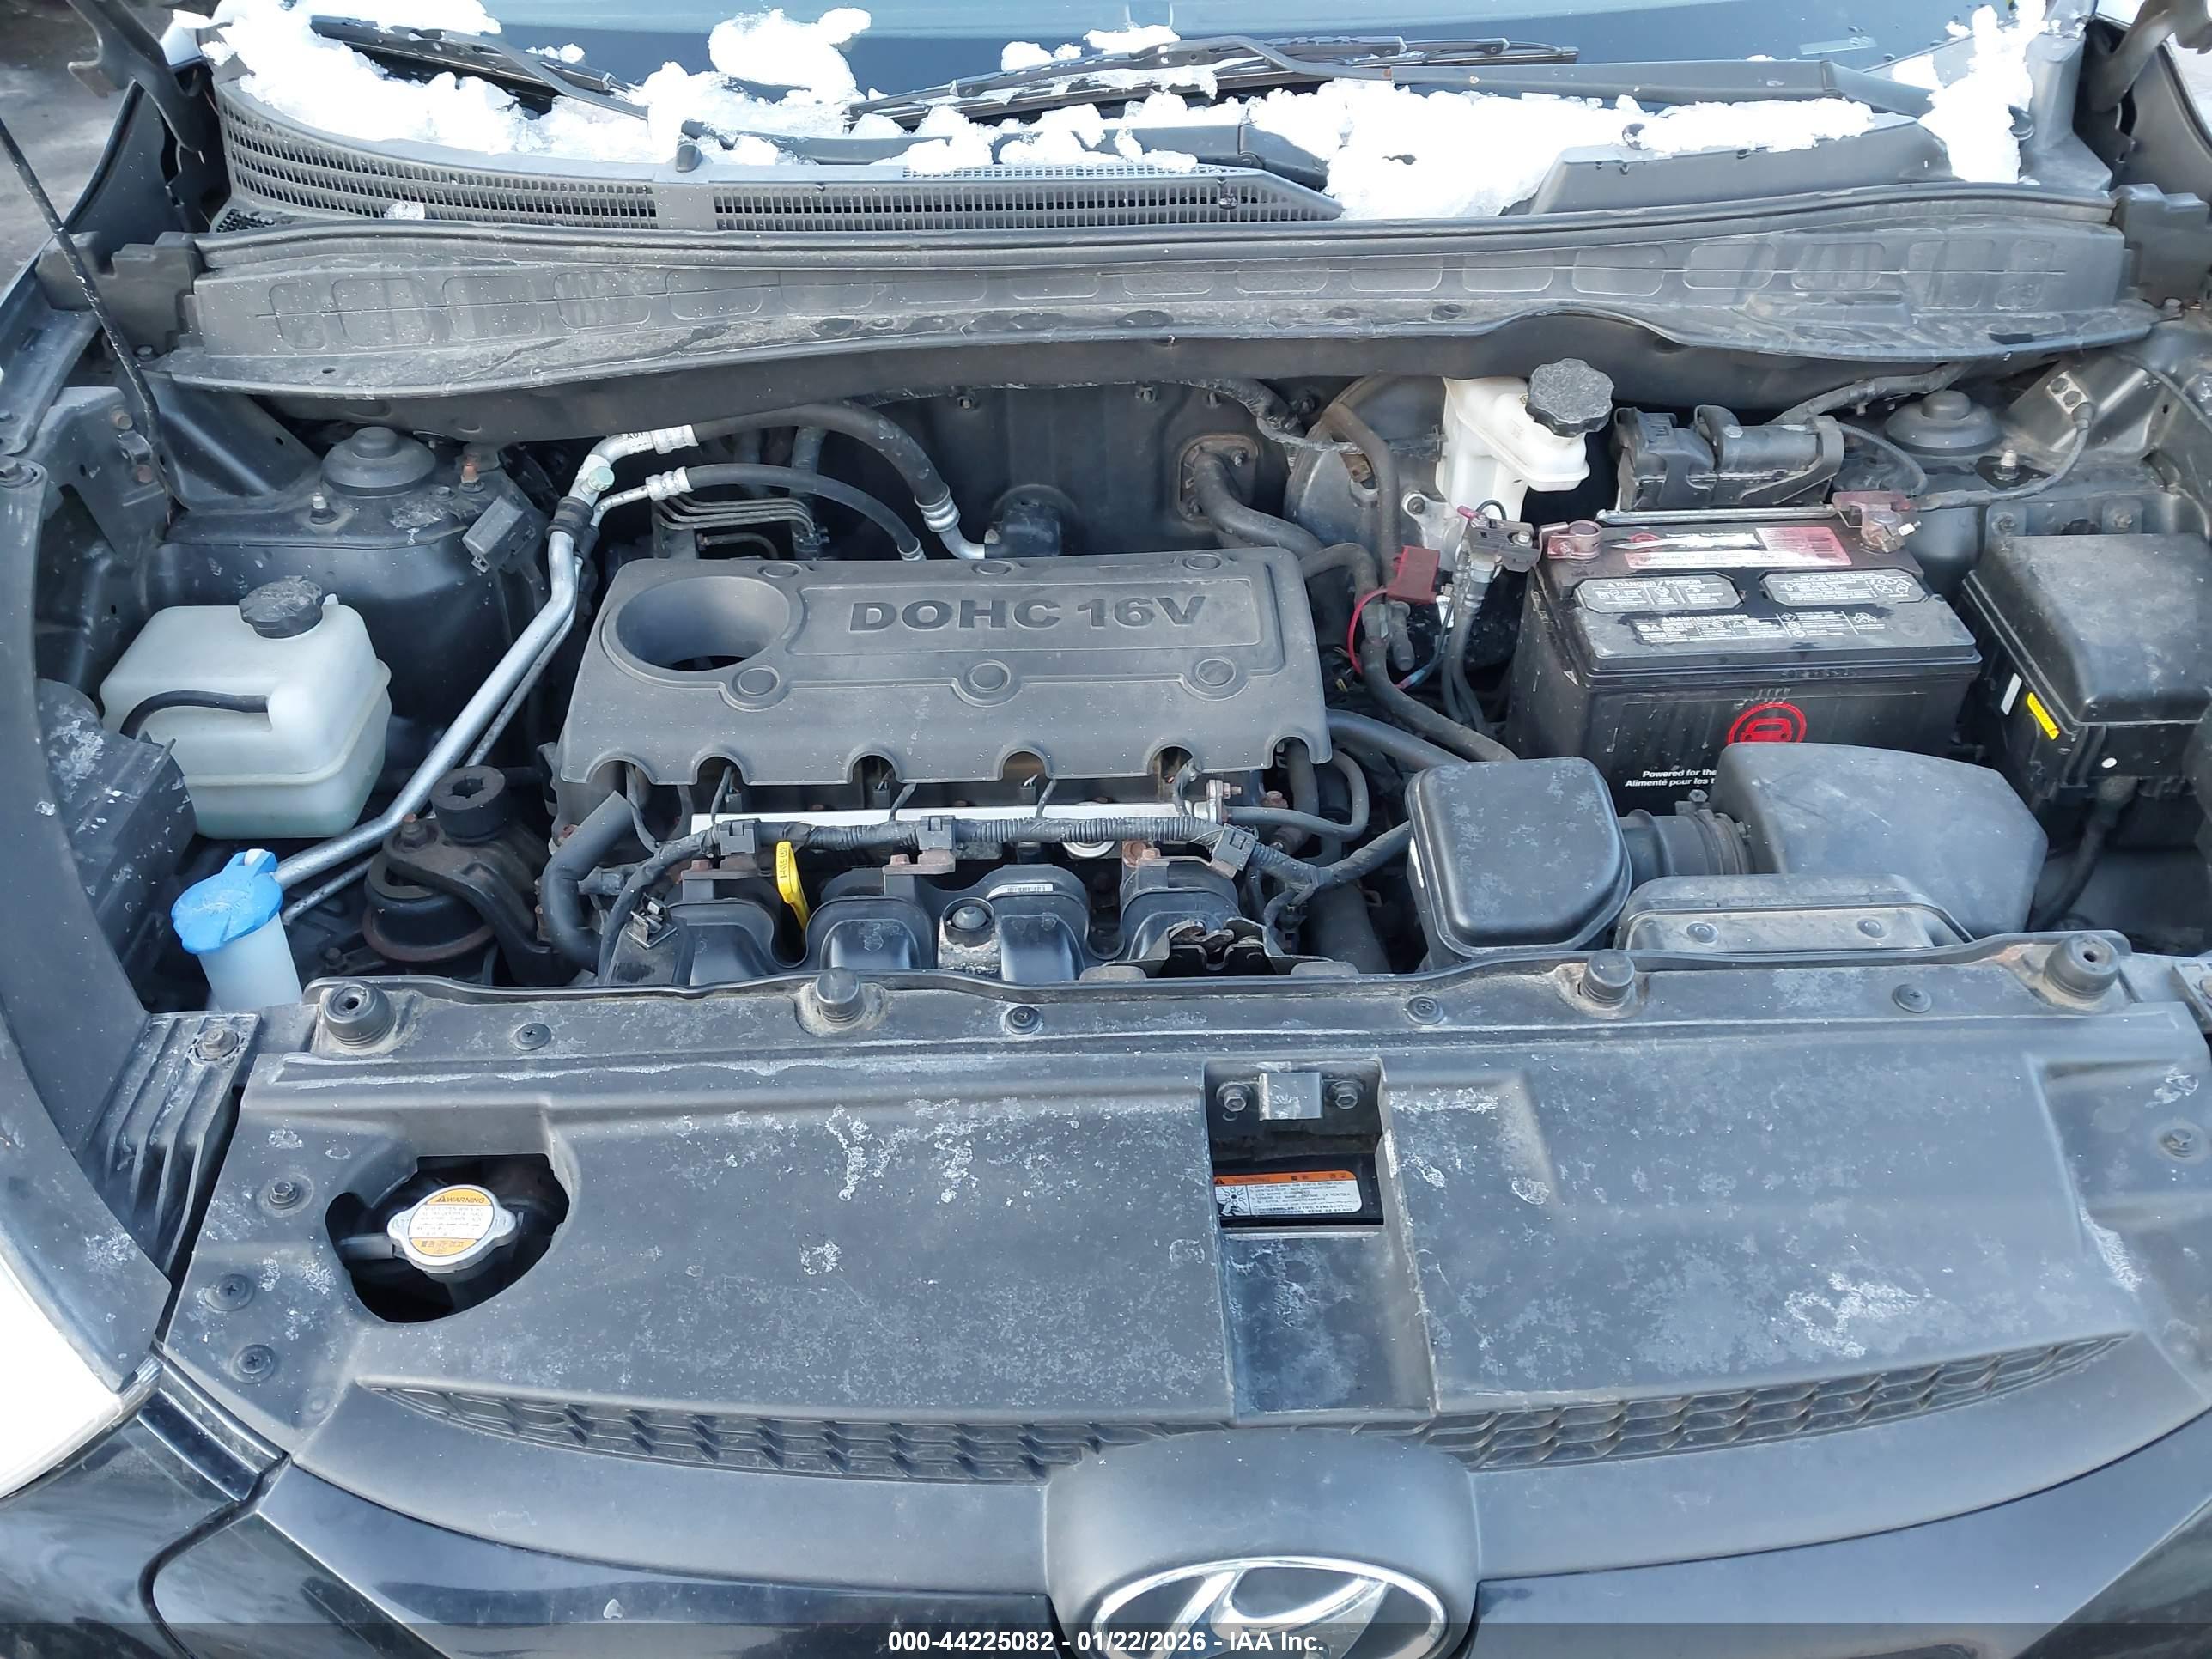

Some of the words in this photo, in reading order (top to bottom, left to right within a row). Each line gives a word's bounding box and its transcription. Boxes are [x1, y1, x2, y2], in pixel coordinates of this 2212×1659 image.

[848, 599, 1061, 632] DOHC
[1077, 596, 1206, 628] 16V
[1669, 779, 1692, 787] pour
[447, 1195, 485, 1204] WARNING
